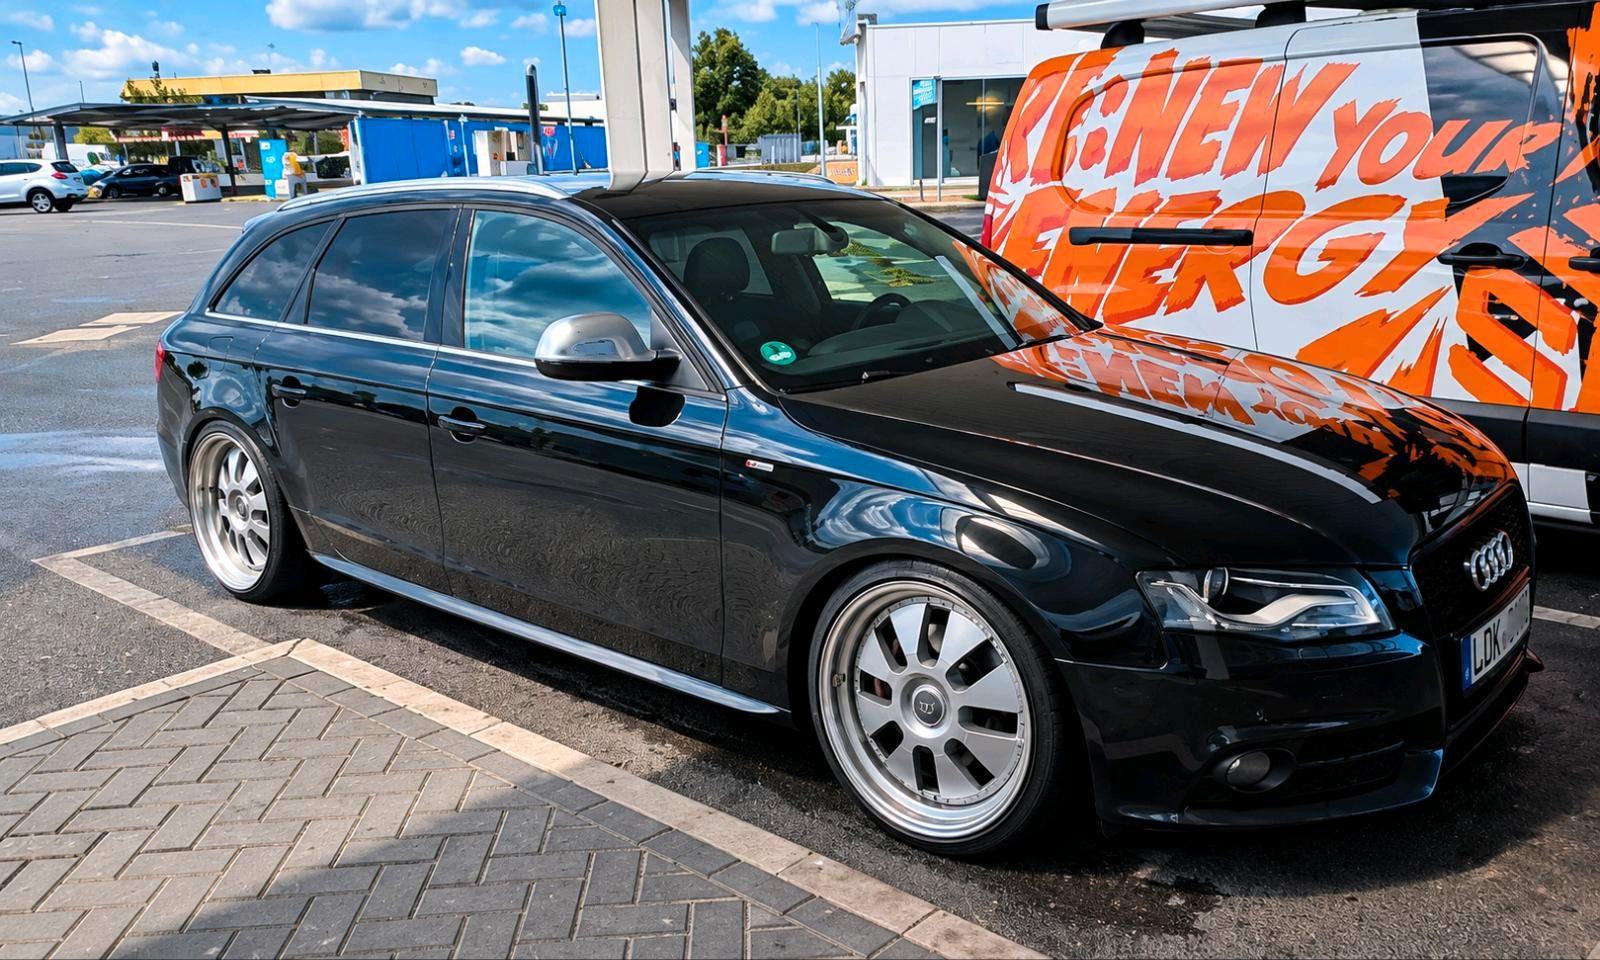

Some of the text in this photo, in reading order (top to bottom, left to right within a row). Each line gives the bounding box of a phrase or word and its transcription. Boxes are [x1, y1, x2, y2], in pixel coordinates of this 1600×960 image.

[1006, 48, 1562, 192] RE:NEW YOUR
[1000, 187, 1536, 325] ENERGY
[1473, 618, 1501, 676] LDK
